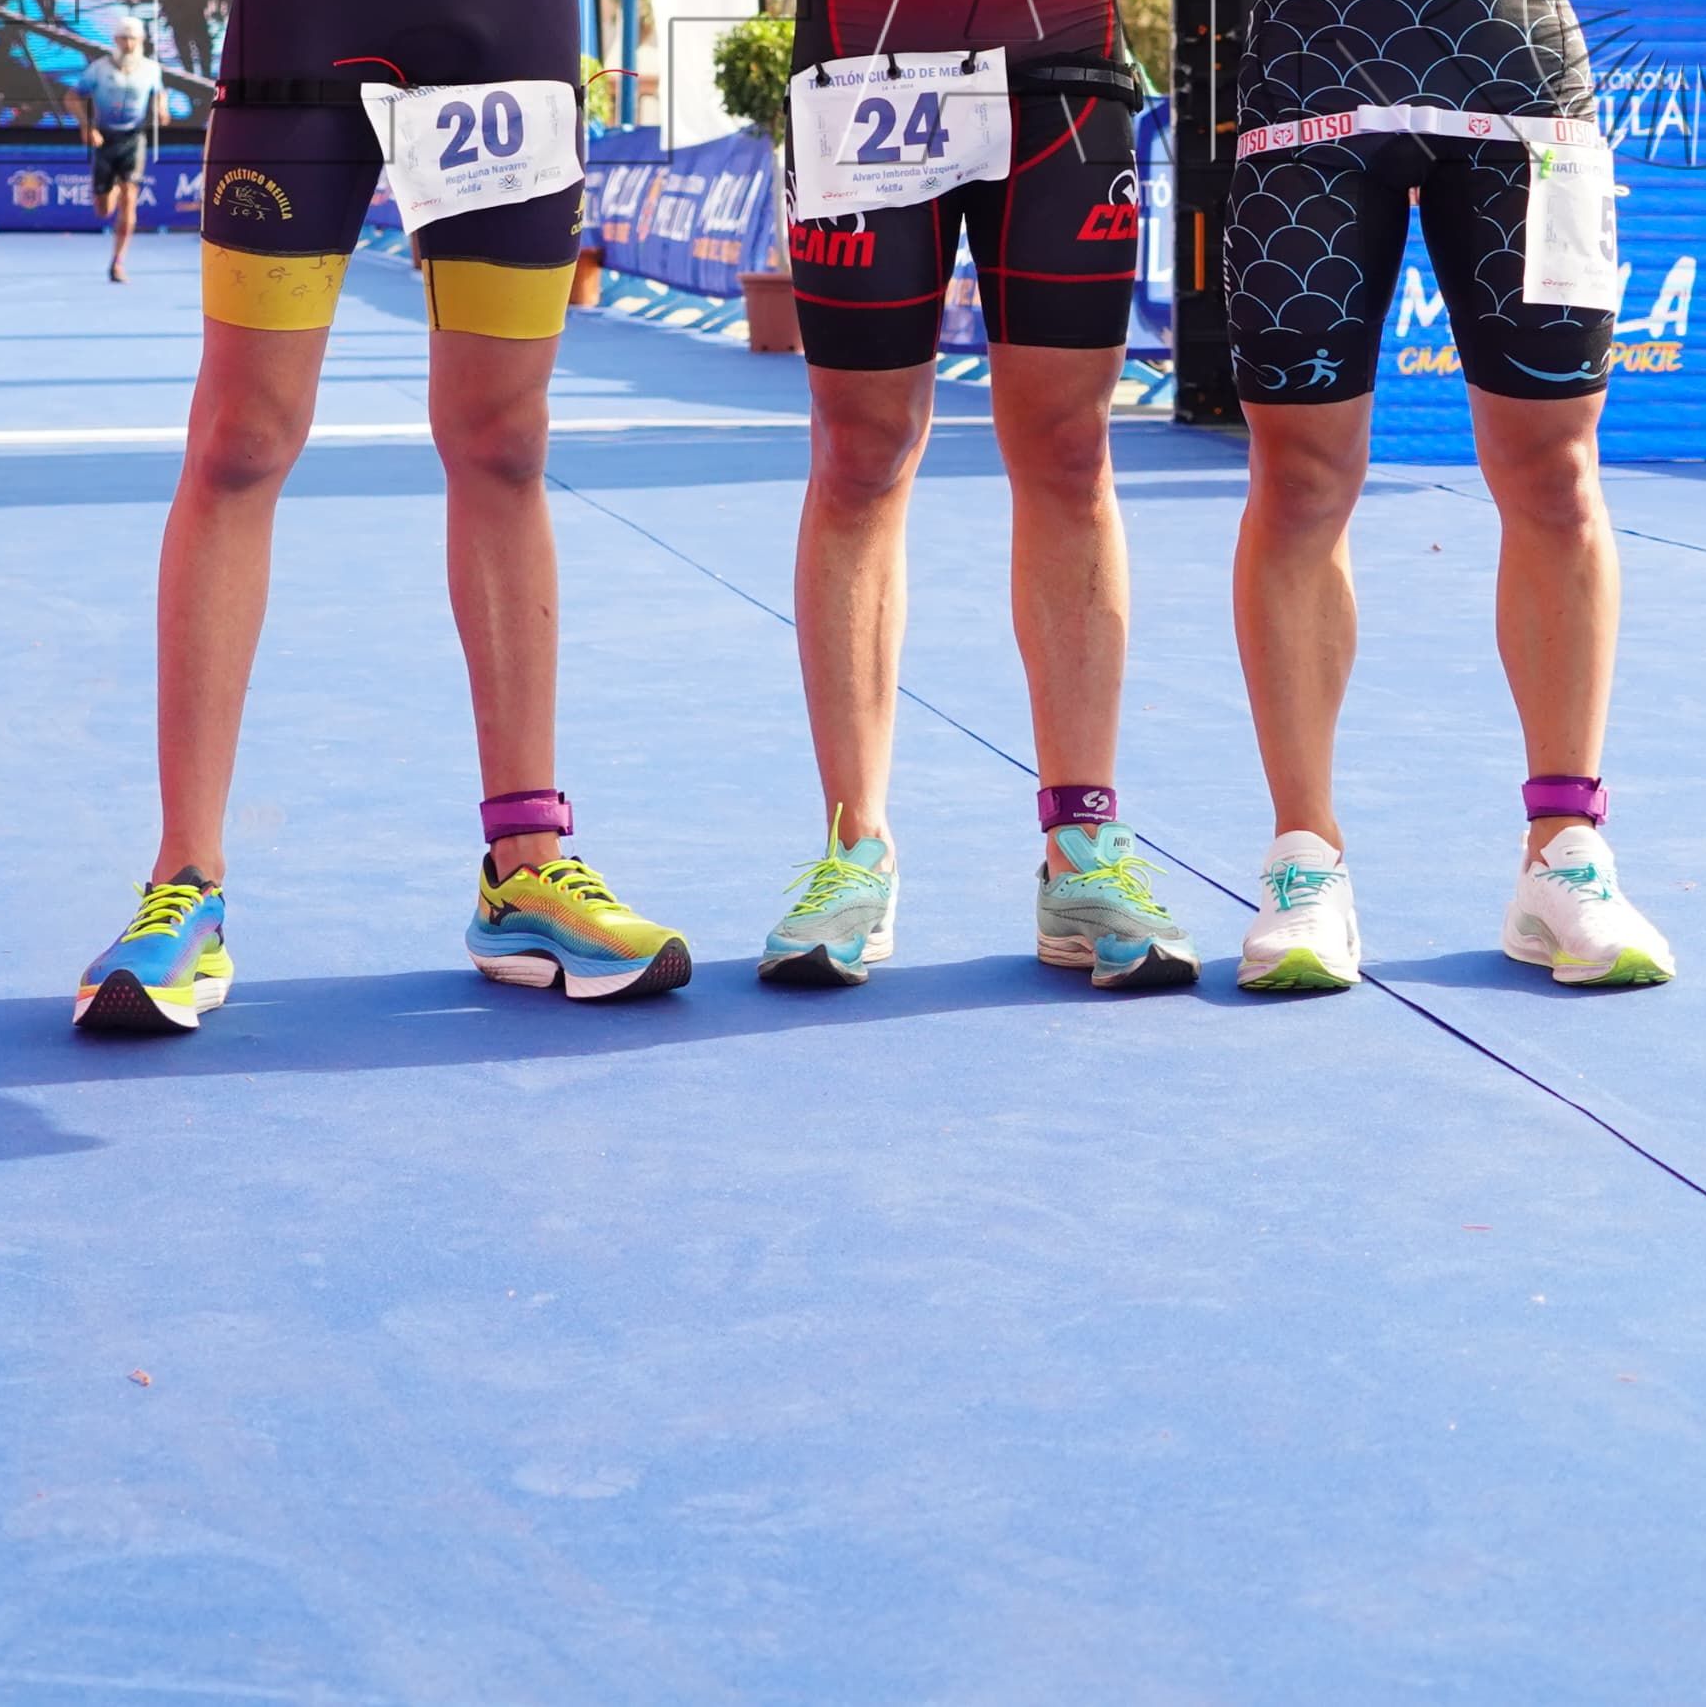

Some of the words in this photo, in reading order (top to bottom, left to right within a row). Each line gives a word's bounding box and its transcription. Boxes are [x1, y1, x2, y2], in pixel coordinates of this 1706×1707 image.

[868, 67, 915, 84] CIUAD
[919, 66, 936, 79] DE
[436, 90, 524, 171] 20
[853, 91, 950, 166] 24
[1239, 128, 1267, 158] OTSO
[1300, 113, 1352, 143] OTSO
[468, 167, 490, 180] Luna
[491, 160, 528, 175] Navarro
[852, 170, 881, 183] Alvaro
[882, 166, 922, 180] Imbroda
[922, 162, 961, 179] Vazquez
[212, 180, 227, 207] CLUB
[223, 166, 265, 186] ATLÉTICO
[264, 178, 293, 221] MELILLA
